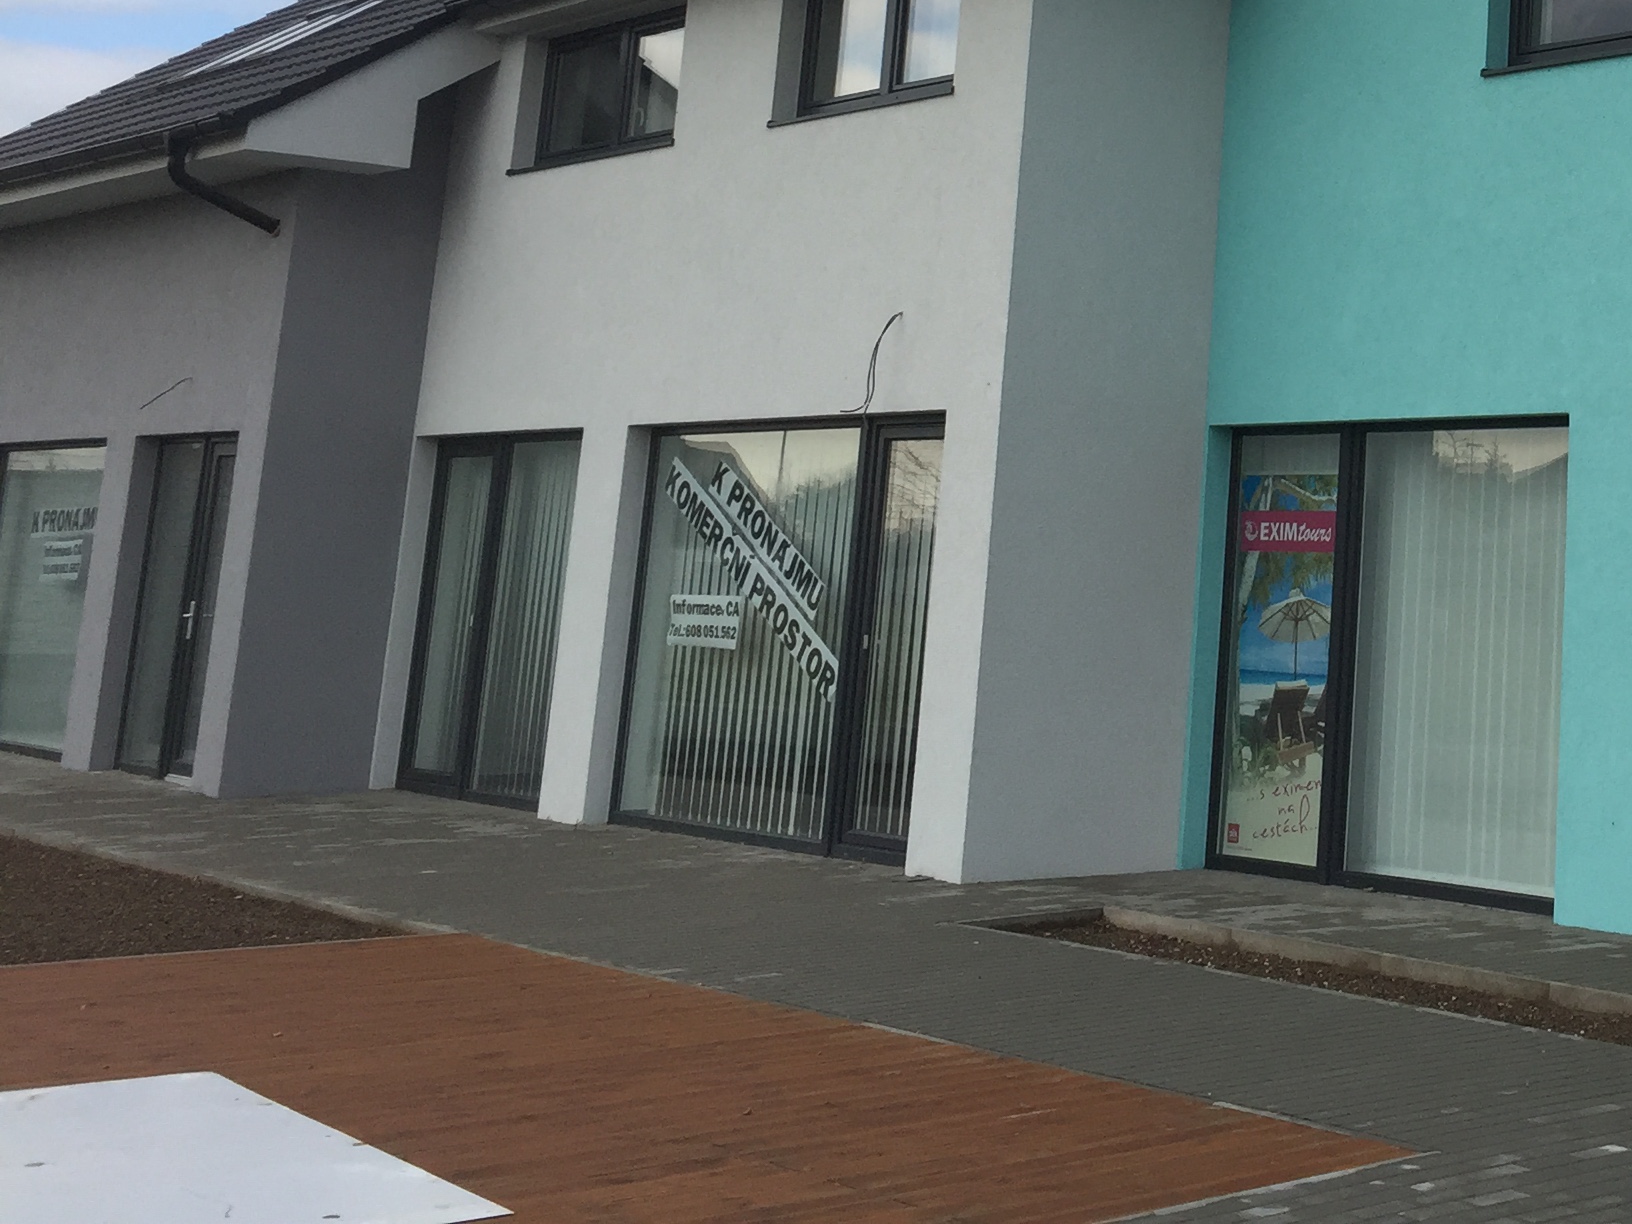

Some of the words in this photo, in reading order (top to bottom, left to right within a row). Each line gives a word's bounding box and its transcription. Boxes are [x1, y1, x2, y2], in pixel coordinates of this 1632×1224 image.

[711, 460, 731, 497] K
[726, 479, 825, 612] PRONÁJMU
[1260, 522, 1332, 542] EXIMtours
[665, 464, 756, 590] KOMERČNÍ
[749, 572, 837, 702] PROSTOR
[725, 601, 740, 617] CA
[1278, 804, 1295, 816] na
